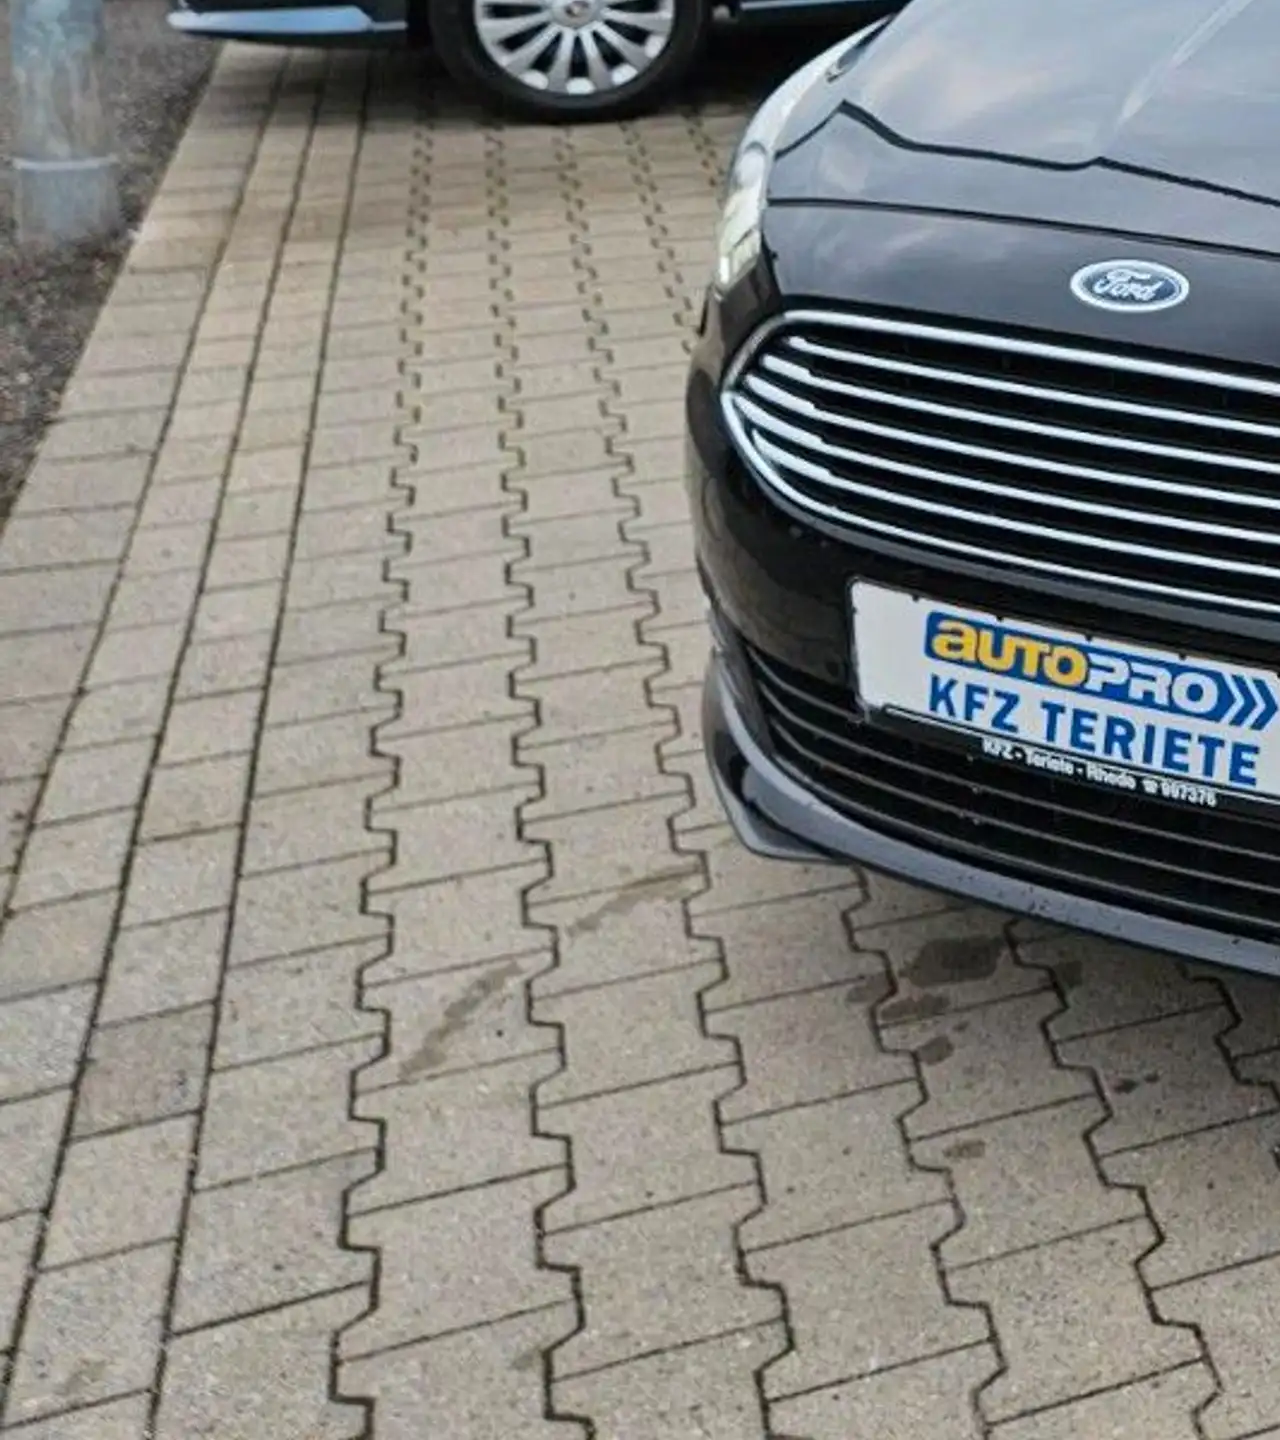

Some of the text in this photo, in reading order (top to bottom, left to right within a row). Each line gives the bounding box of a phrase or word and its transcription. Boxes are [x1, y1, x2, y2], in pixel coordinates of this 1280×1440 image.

[1092, 268, 1166, 302] Ford
[929, 673, 1261, 786] KFZ TERIETE
